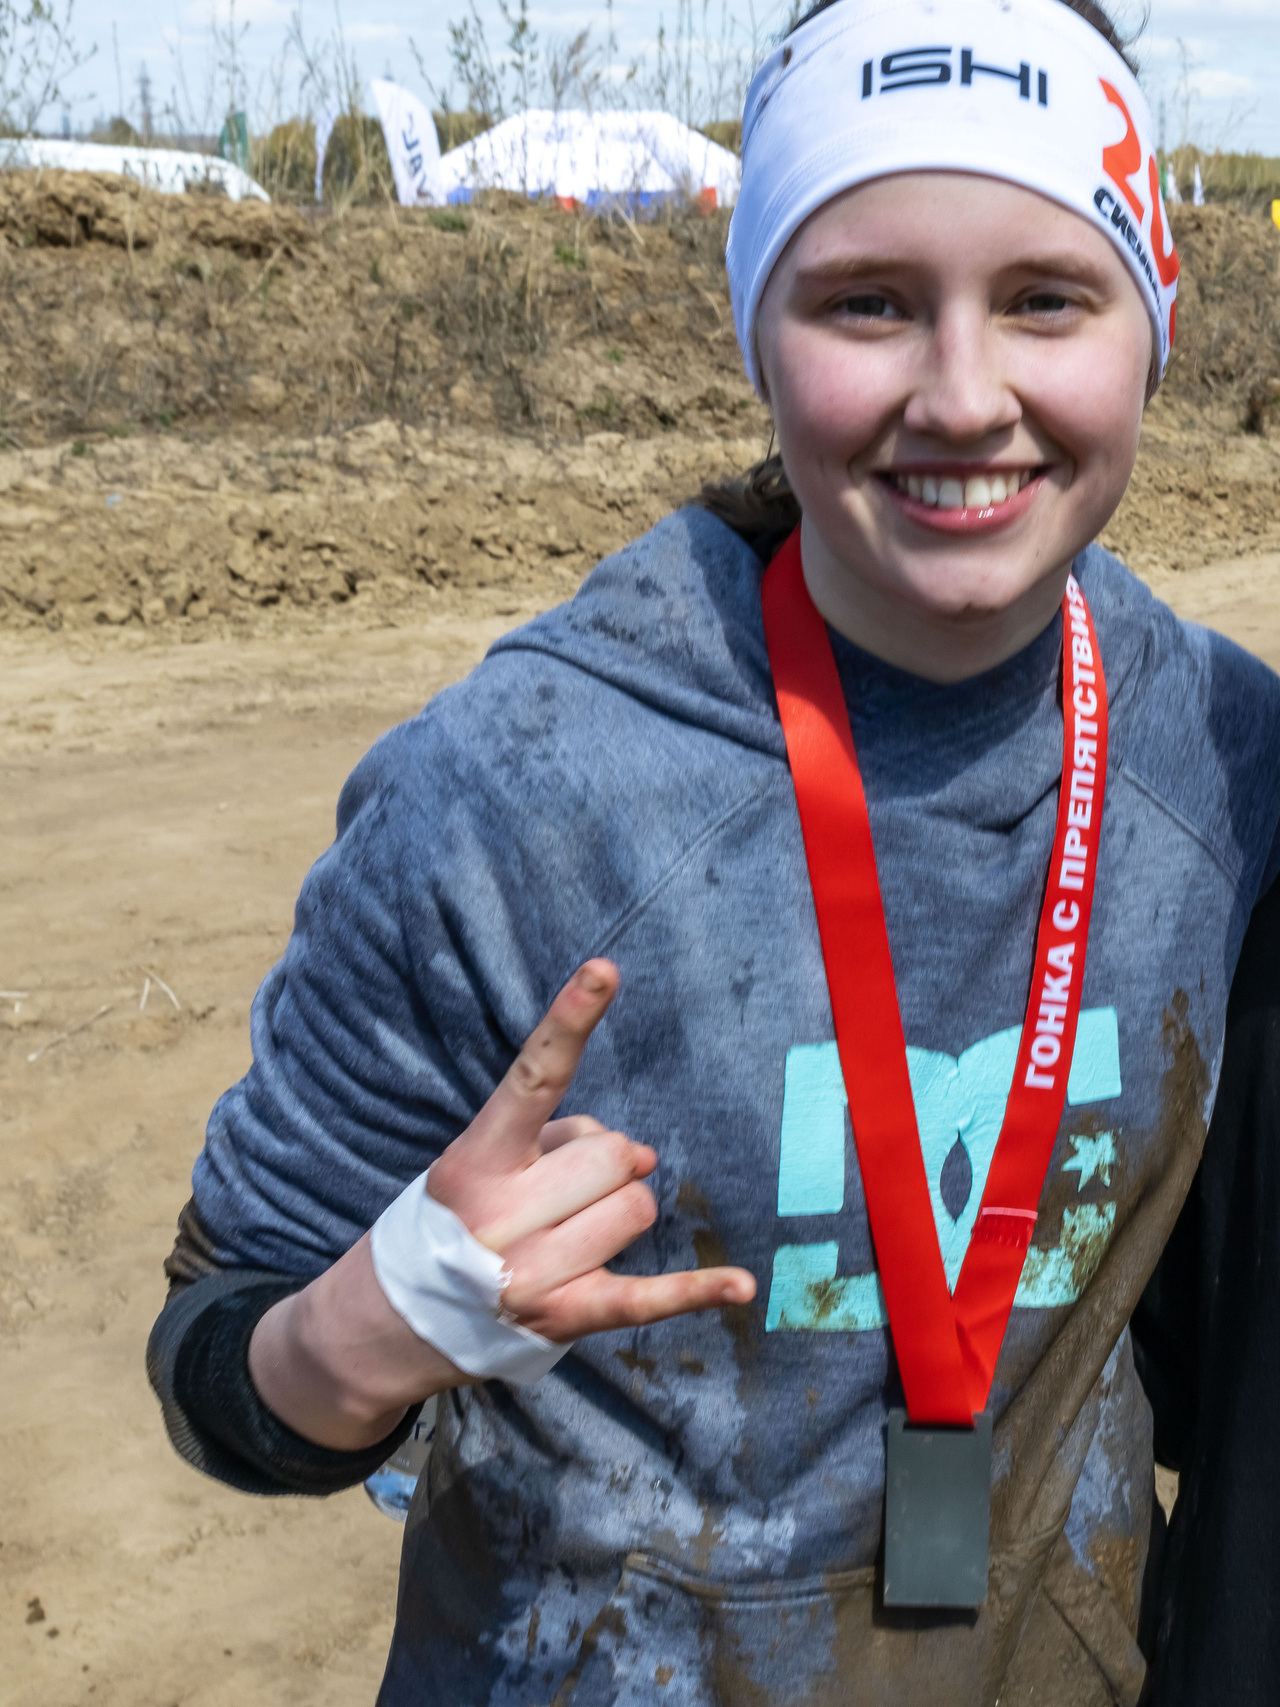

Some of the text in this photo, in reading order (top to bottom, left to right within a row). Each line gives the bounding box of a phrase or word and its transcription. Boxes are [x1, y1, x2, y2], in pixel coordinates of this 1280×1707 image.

[862, 46, 1047, 108] ISHI
[1024, 942, 1076, 1090] ГОНКА
[1052, 899, 1080, 932] С
